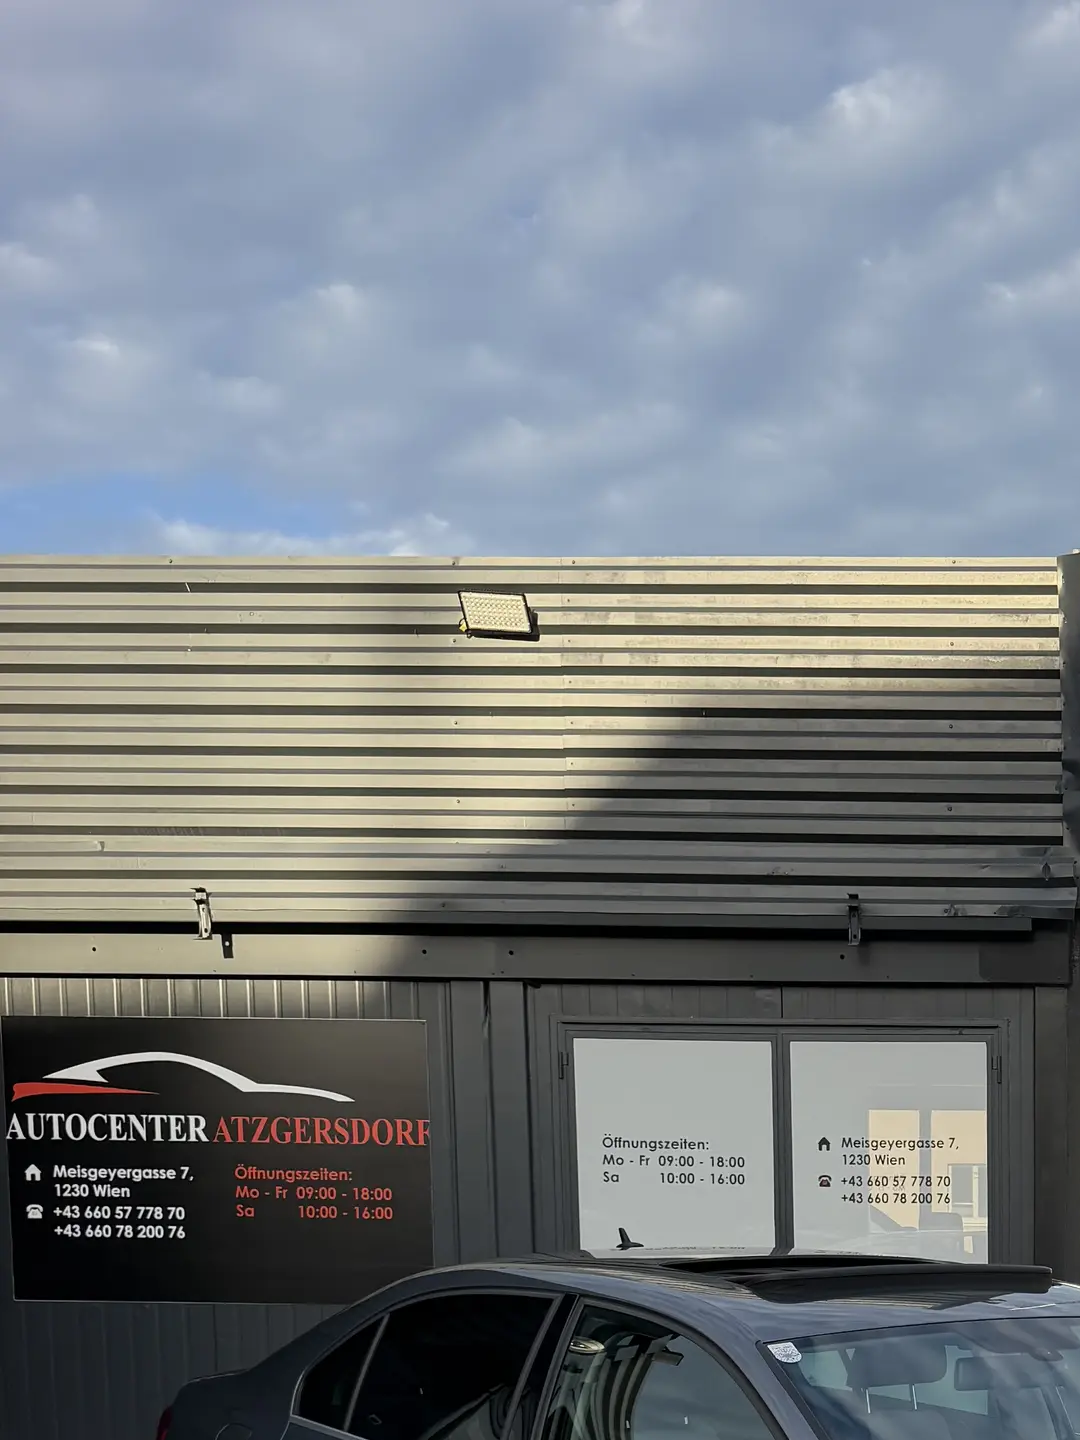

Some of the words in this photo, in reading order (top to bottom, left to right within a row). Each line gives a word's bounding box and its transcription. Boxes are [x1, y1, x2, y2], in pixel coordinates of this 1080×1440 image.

[6, 1113, 209, 1142] AUTOCENTER
[602, 1133, 709, 1151] Öffnungszeiten:
[841, 1137, 944, 1151] Meisgeyergasse
[948, 1137, 959, 1150] 7,
[602, 1154, 624, 1165] Mo
[639, 1155, 650, 1166] Fr
[658, 1155, 695, 1167] 09:00
[710, 1156, 745, 1168] 18:00
[842, 1154, 870, 1165] 1230
[875, 1154, 905, 1165] Wien
[53, 1165, 176, 1182] Meisgeyergasse
[180, 1166, 194, 1181] 7,
[234, 1164, 352, 1182] Öffnungszeiten:
[603, 1171, 619, 1183] Sa
[660, 1172, 695, 1184] 10:00
[710, 1173, 745, 1185] 16:00
[841, 1176, 863, 1187] +43
[867, 1176, 889, 1187] 660
[892, 1176, 907, 1187] 57
[911, 1176, 932, 1187] 778
[936, 1176, 951, 1187] 70
[55, 1184, 89, 1197] 1230
[93, 1184, 130, 1198] Wien
[235, 1186, 259, 1198] Mo
[275, 1186, 288, 1199] Fr
[296, 1187, 336, 1200] 09:00
[353, 1188, 392, 1201] 18:00
[841, 1193, 863, 1204] +43
[867, 1193, 889, 1204] 660
[893, 1193, 907, 1204] 78
[911, 1193, 932, 1204] 200
[937, 1193, 951, 1204] 76
[53, 1205, 80, 1219] +43
[84, 1206, 111, 1219] 660
[115, 1206, 132, 1219] 57
[136, 1207, 163, 1220] 778
[167, 1207, 185, 1220] 70
[236, 1205, 254, 1217] Sa
[298, 1206, 337, 1219] 10:00
[354, 1207, 393, 1220] 16:00
[54, 1225, 81, 1237] +43
[85, 1225, 111, 1238] 660
[116, 1225, 133, 1238] 78
[137, 1226, 164, 1239] 200
[168, 1226, 185, 1239] 76
